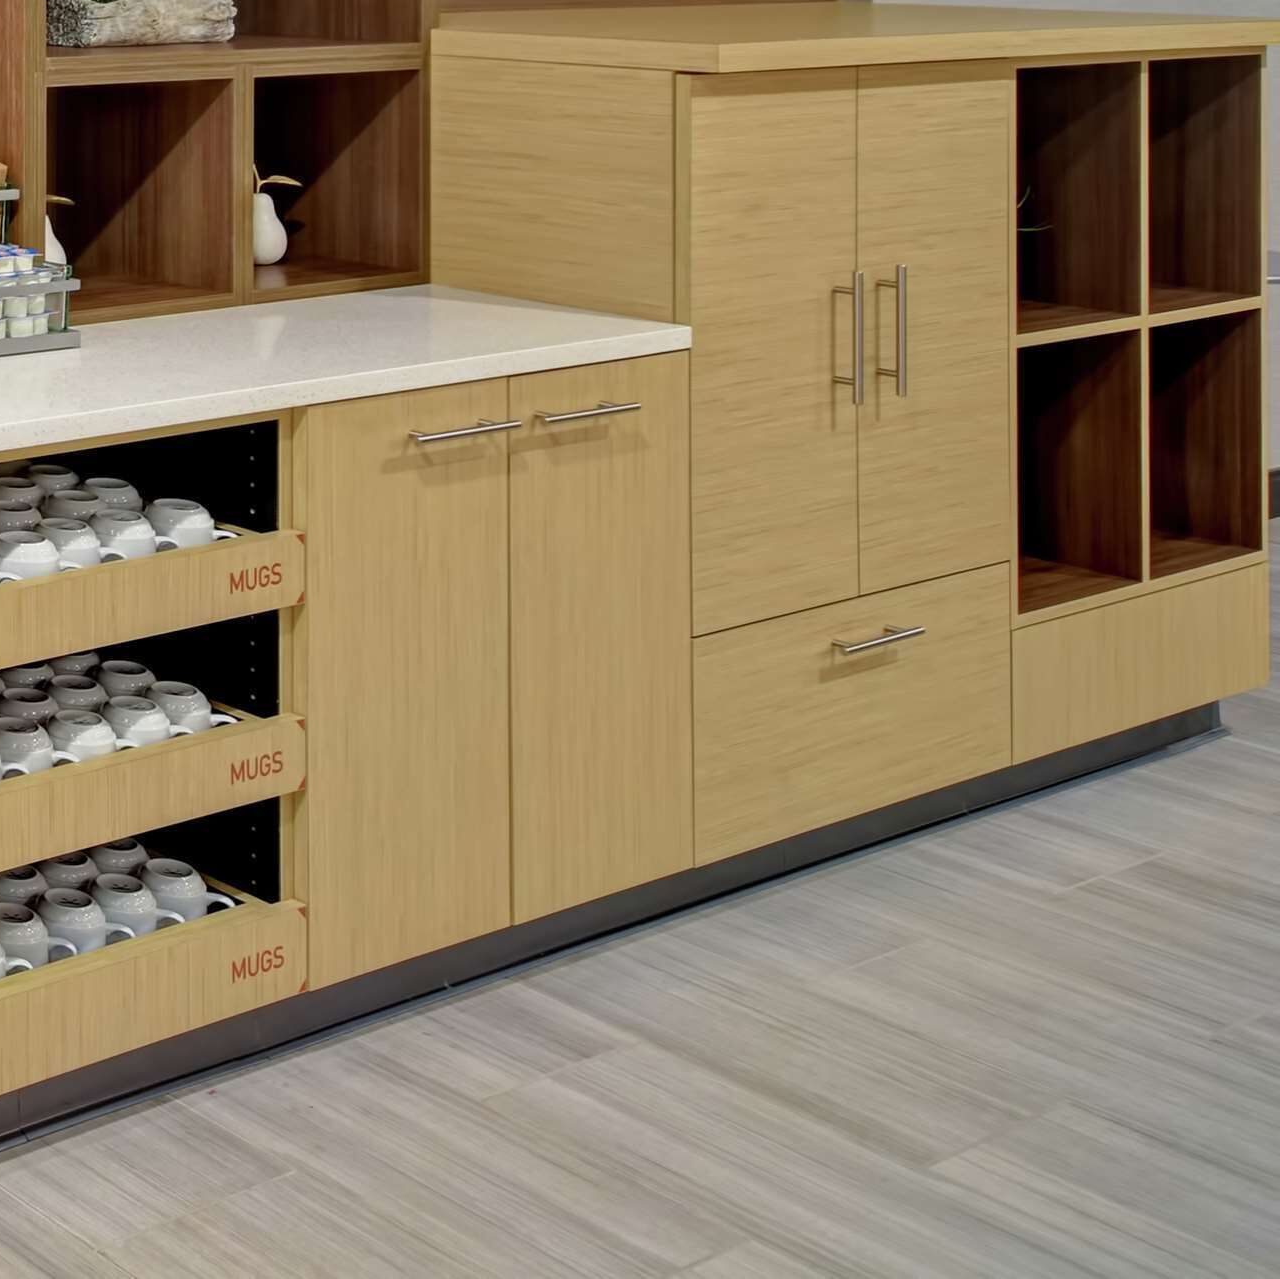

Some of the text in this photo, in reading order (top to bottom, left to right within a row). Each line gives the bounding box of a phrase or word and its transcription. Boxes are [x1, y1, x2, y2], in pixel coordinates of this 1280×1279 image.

[229, 562, 283, 594] MUGS
[230, 751, 284, 784] MUGS
[230, 946, 285, 984] MUGS
